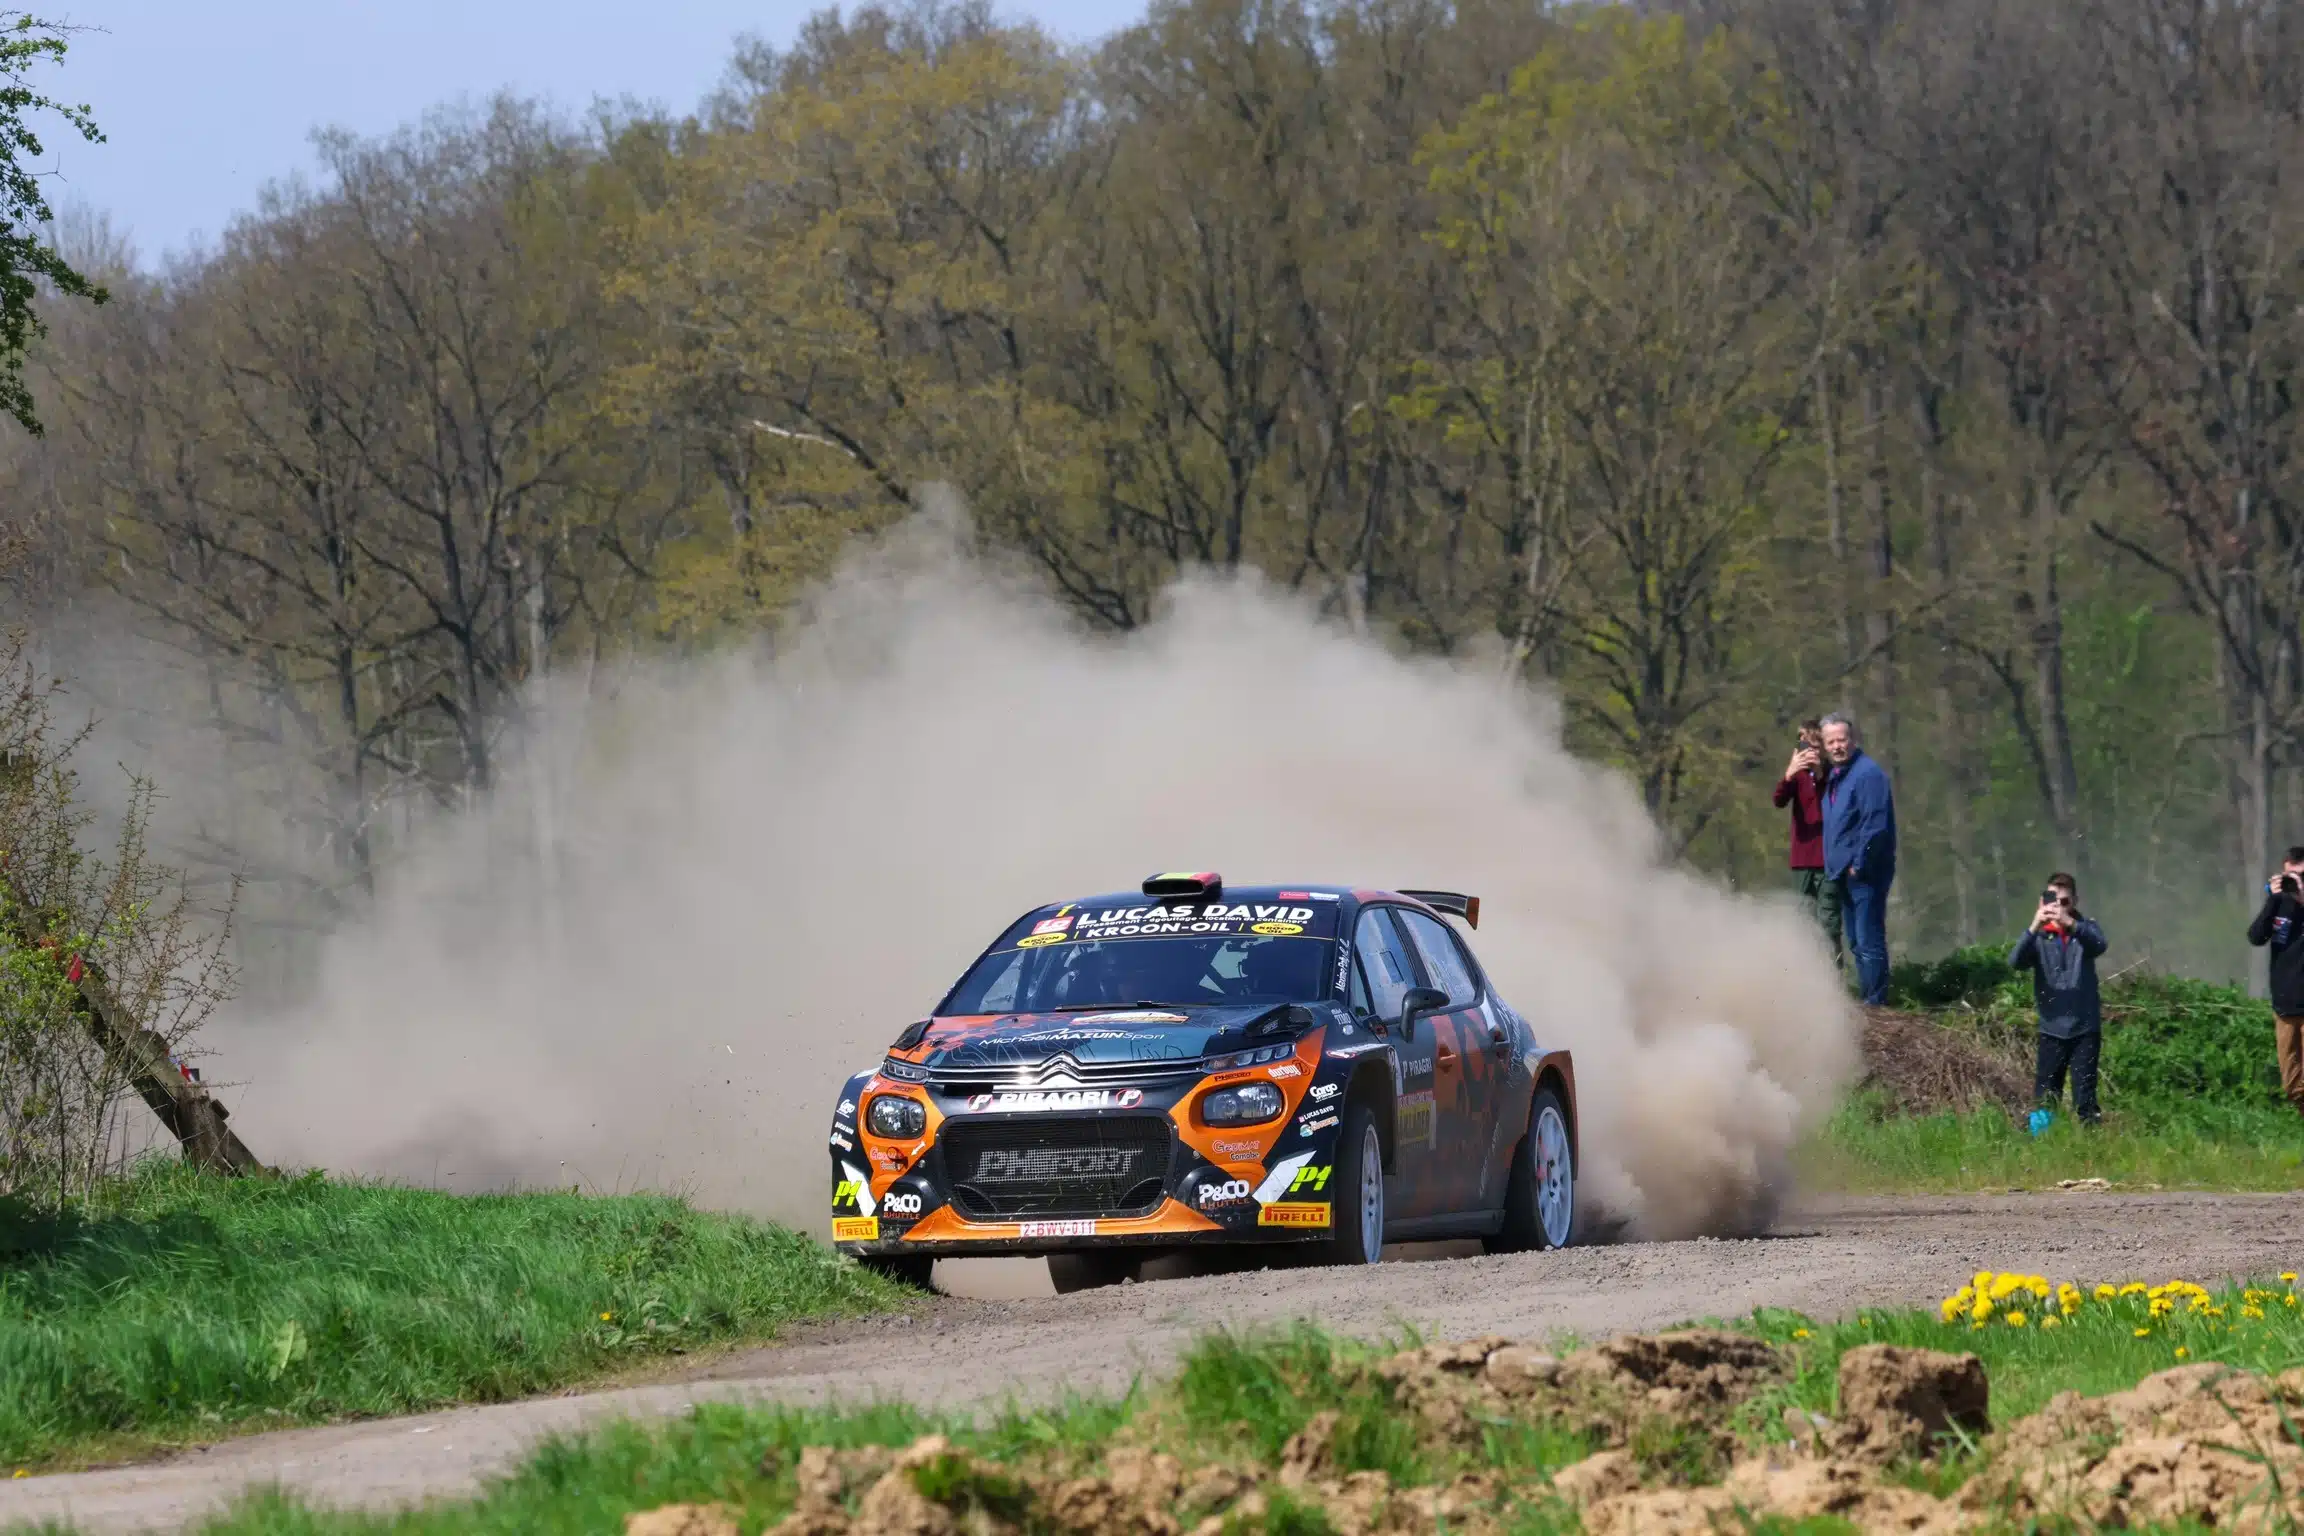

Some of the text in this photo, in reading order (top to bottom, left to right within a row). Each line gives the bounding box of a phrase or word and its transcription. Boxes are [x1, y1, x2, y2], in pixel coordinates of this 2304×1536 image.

[1076, 917, 1141, 930] terrassement
[1257, 916, 1308, 925] containers
[1077, 905, 1314, 926] LUCAS DAVID
[1086, 922, 1231, 938] KROON-OIL
[1409, 1057, 1434, 1077] PIRAGRI
[1000, 1090, 1110, 1108] PIRAGRI
[1309, 1083, 1338, 1098] Cargo
[1304, 1105, 1335, 1121] LUCAS DAVID
[1198, 1180, 1250, 1203] P&CO
[883, 1193, 922, 1213] P&CO
[1200, 1198, 1250, 1211] SHUTTLE
[883, 1212, 920, 1220] SHUTTLE
[1264, 1206, 1325, 1223] PIRELLI
[837, 1220, 874, 1237] PIRELLI
